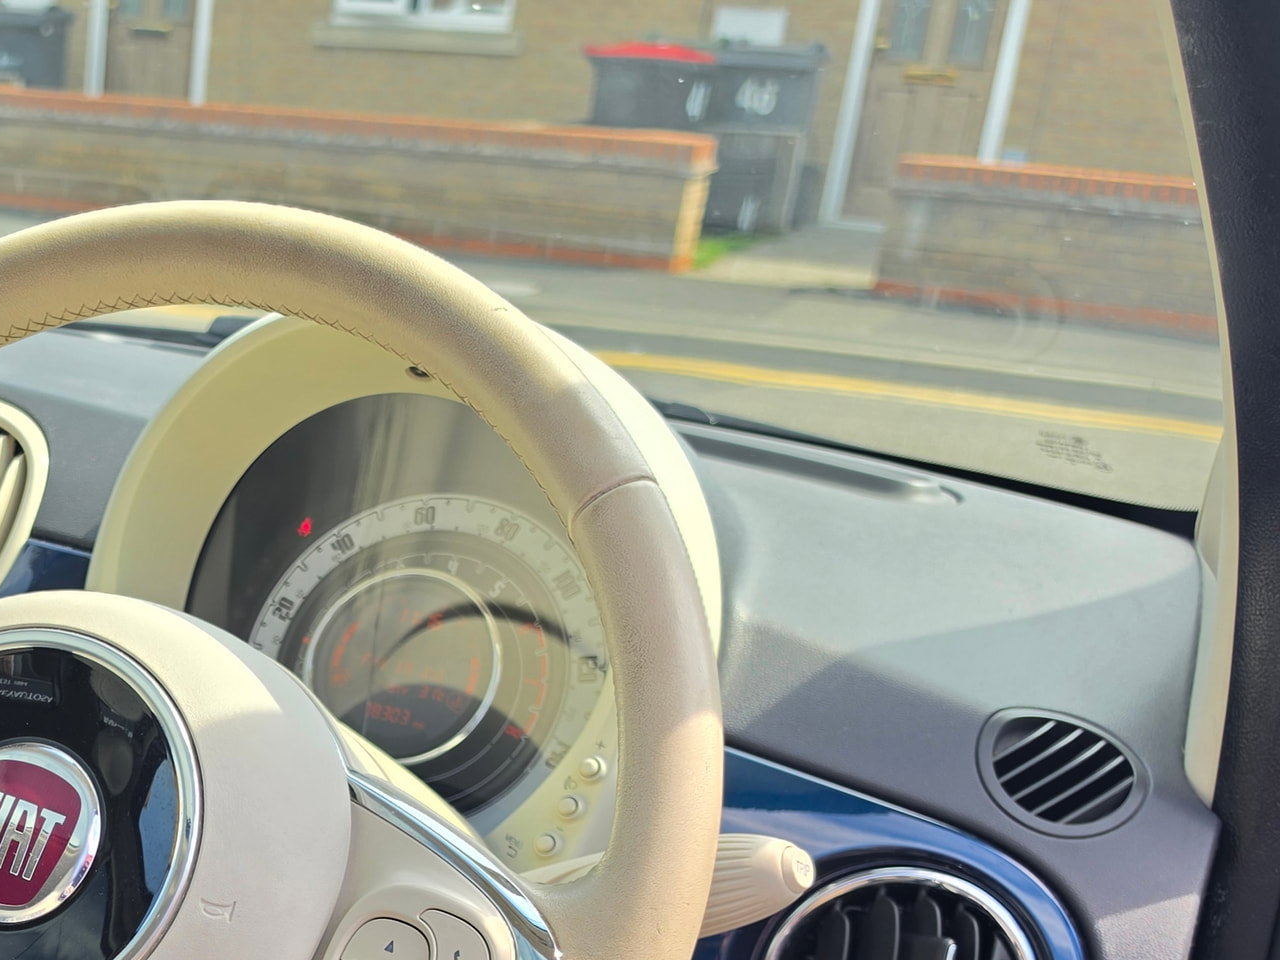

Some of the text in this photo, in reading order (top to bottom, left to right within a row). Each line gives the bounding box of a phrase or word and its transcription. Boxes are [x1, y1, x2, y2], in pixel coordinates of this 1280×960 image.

[414, 505, 436, 526] 60
[494, 518, 520, 541] 80
[330, 533, 355, 554] 40
[552, 570, 582, 602] 100
[272, 597, 295, 622] 20
